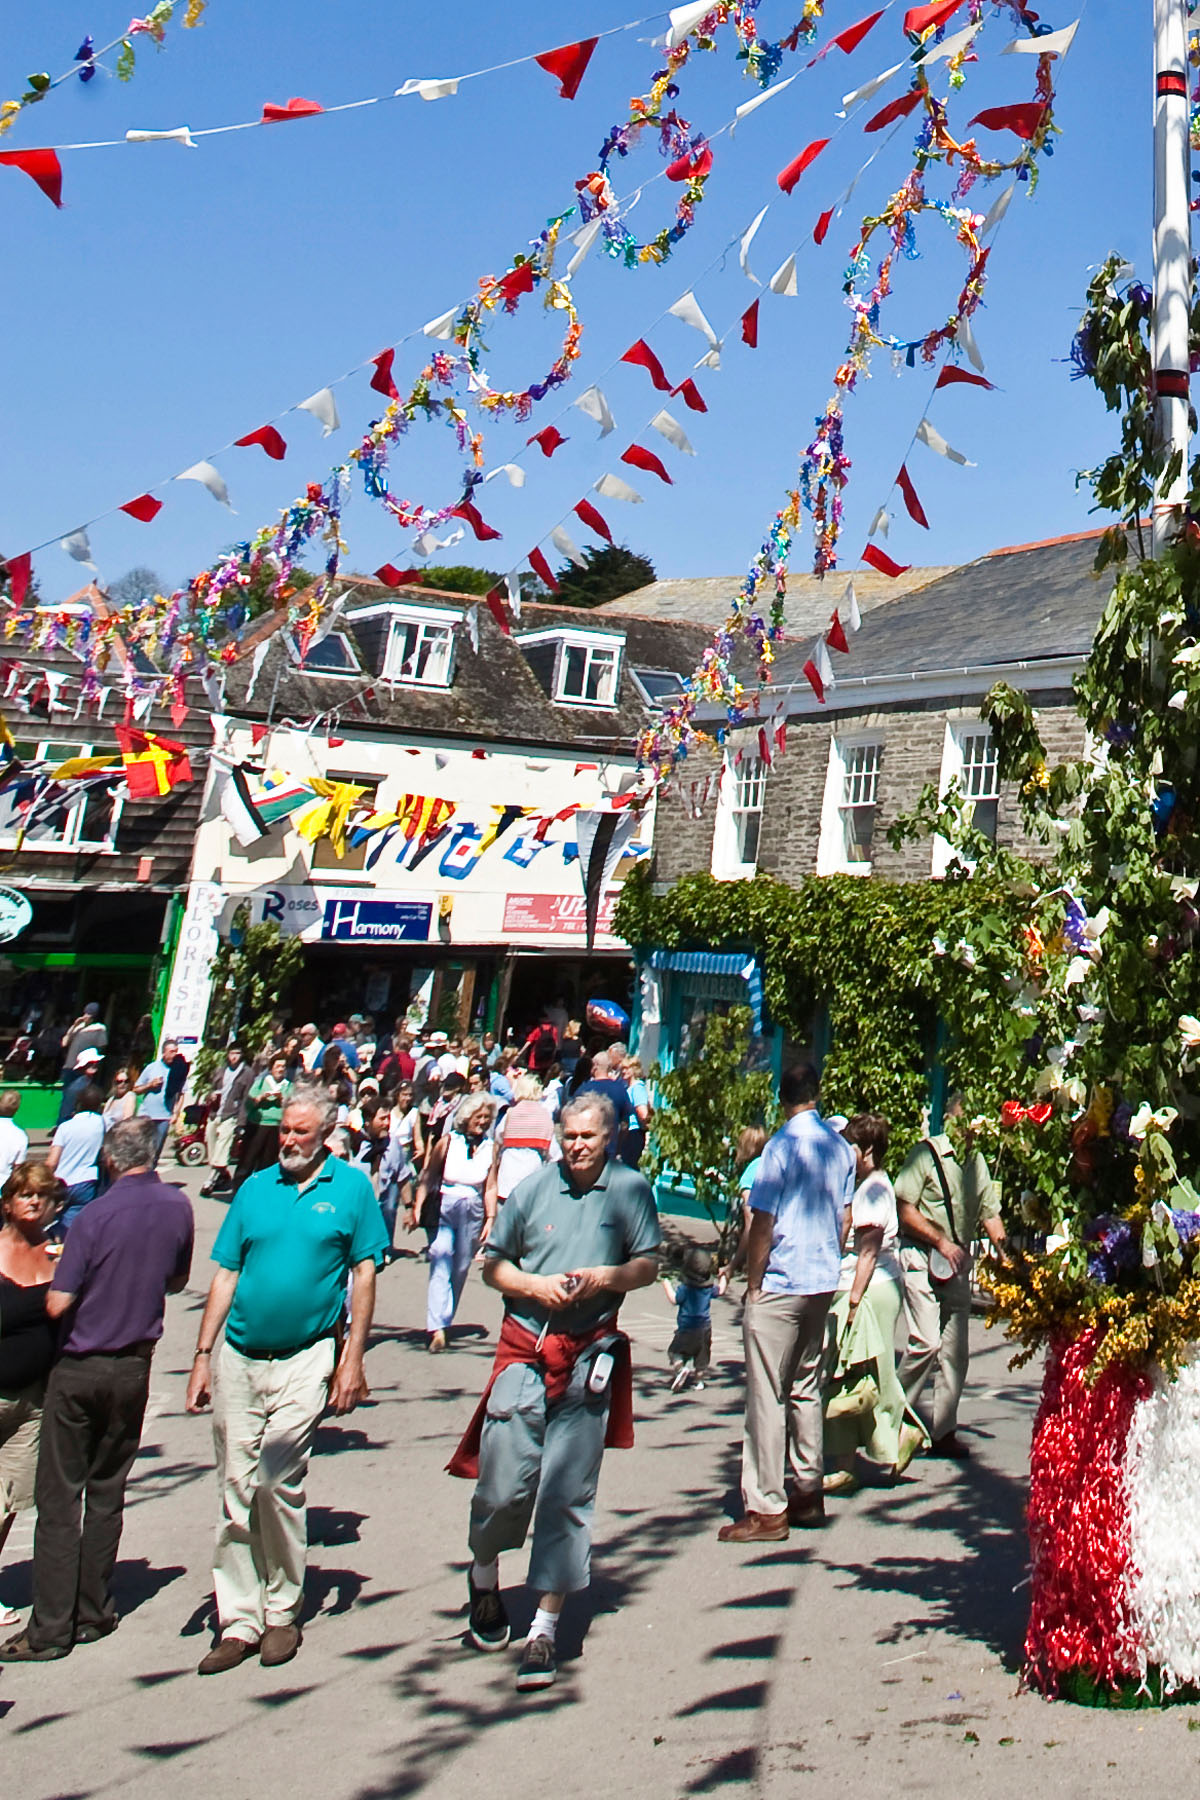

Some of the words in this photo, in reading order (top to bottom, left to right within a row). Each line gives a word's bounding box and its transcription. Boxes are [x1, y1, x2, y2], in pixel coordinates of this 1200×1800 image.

[261, 890, 319, 922] Roses
[331, 901, 406, 940] Harmony
[173, 886, 209, 1022] FLORIST
